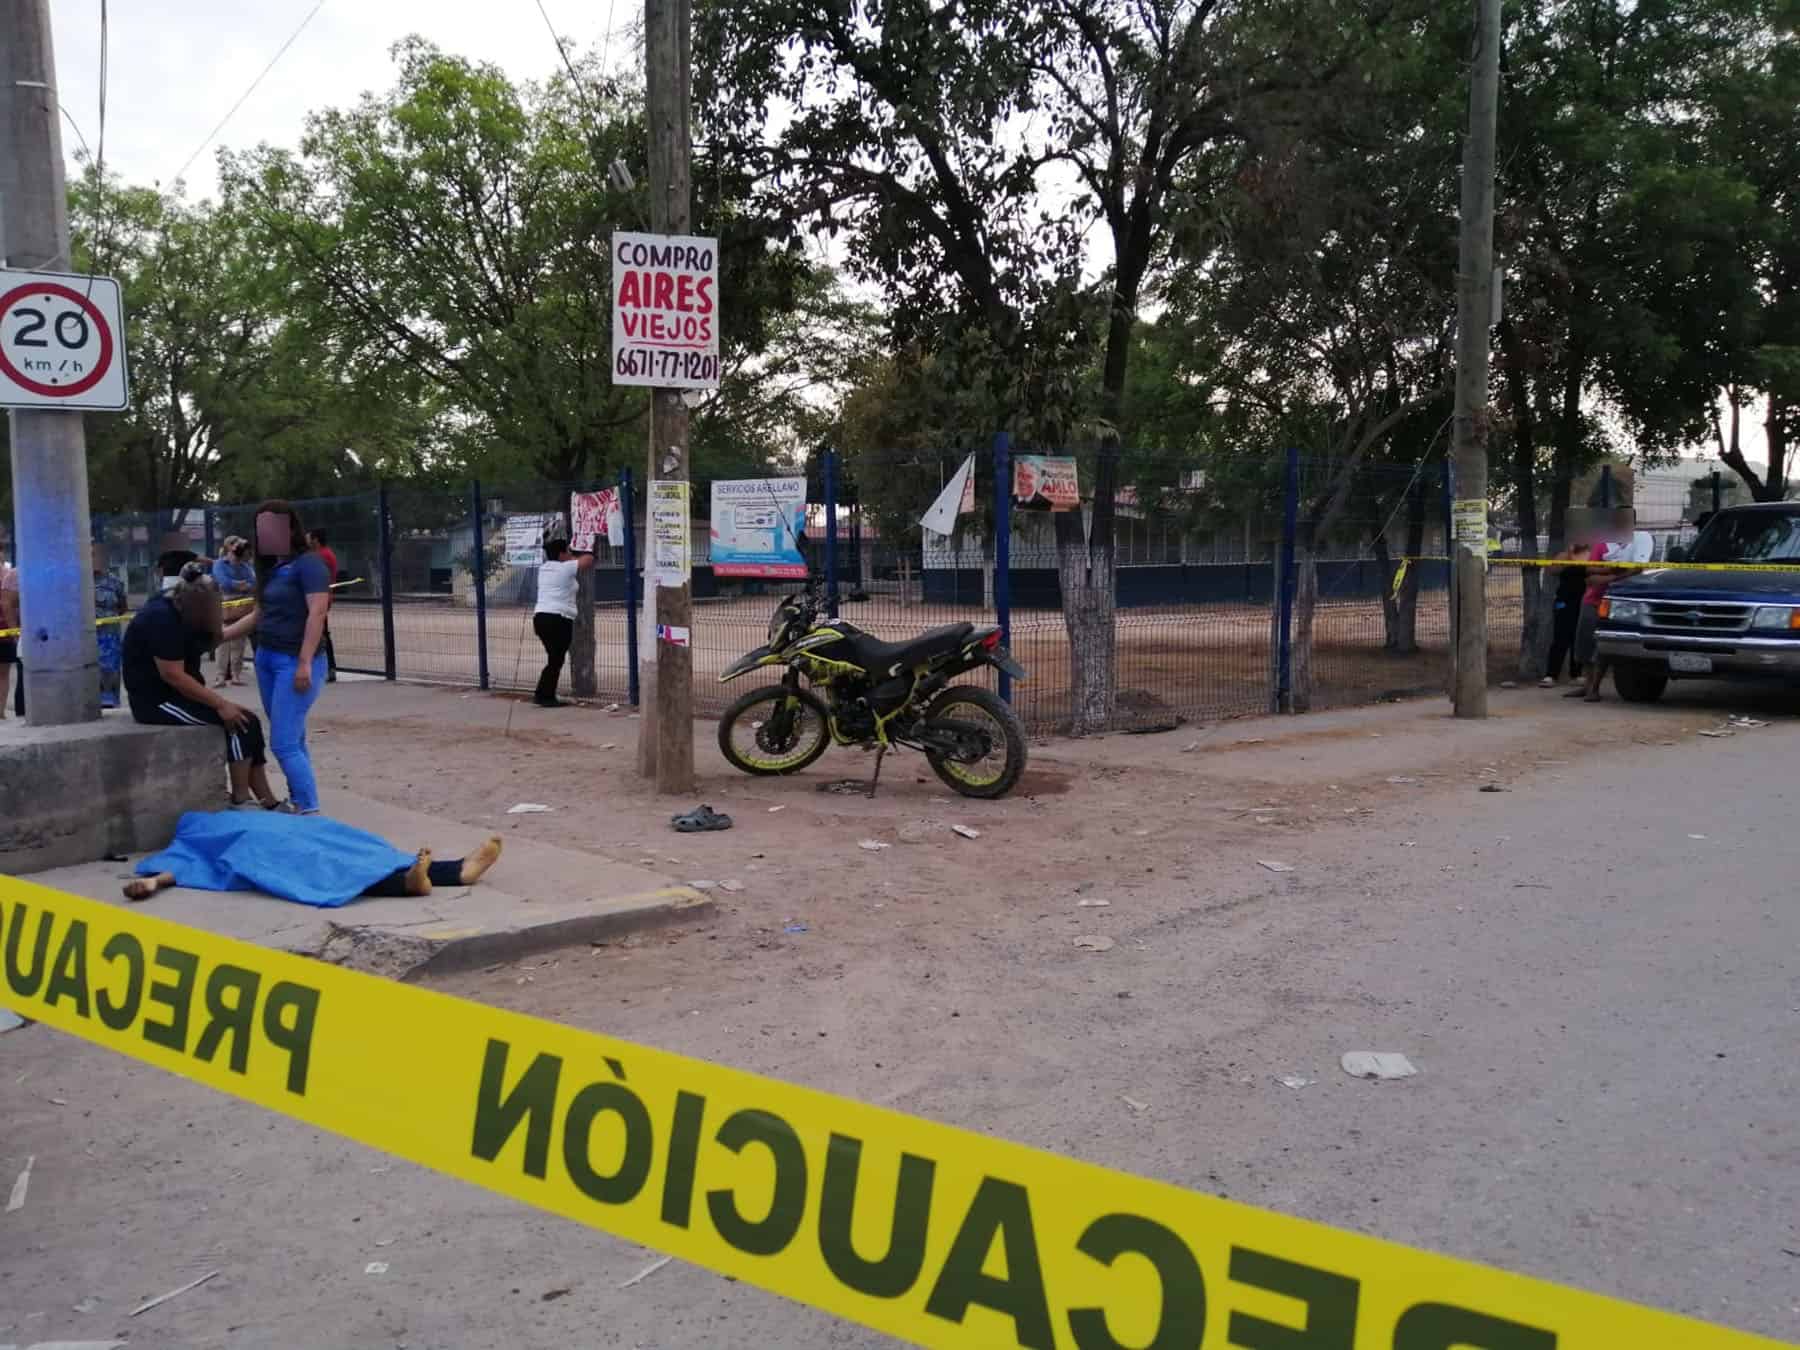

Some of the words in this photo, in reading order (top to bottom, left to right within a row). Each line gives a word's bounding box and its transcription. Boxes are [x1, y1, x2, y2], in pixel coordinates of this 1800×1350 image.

[617, 241, 713, 271] COMPRO
[618, 271, 713, 314] AIRES
[13, 308, 89, 350] 20
[621, 312, 711, 341] VIEJOS
[718, 484, 755, 494] SERVICIOS
[757, 481, 800, 494] ARELLANO
[1041, 480, 1077, 495] AMLO
